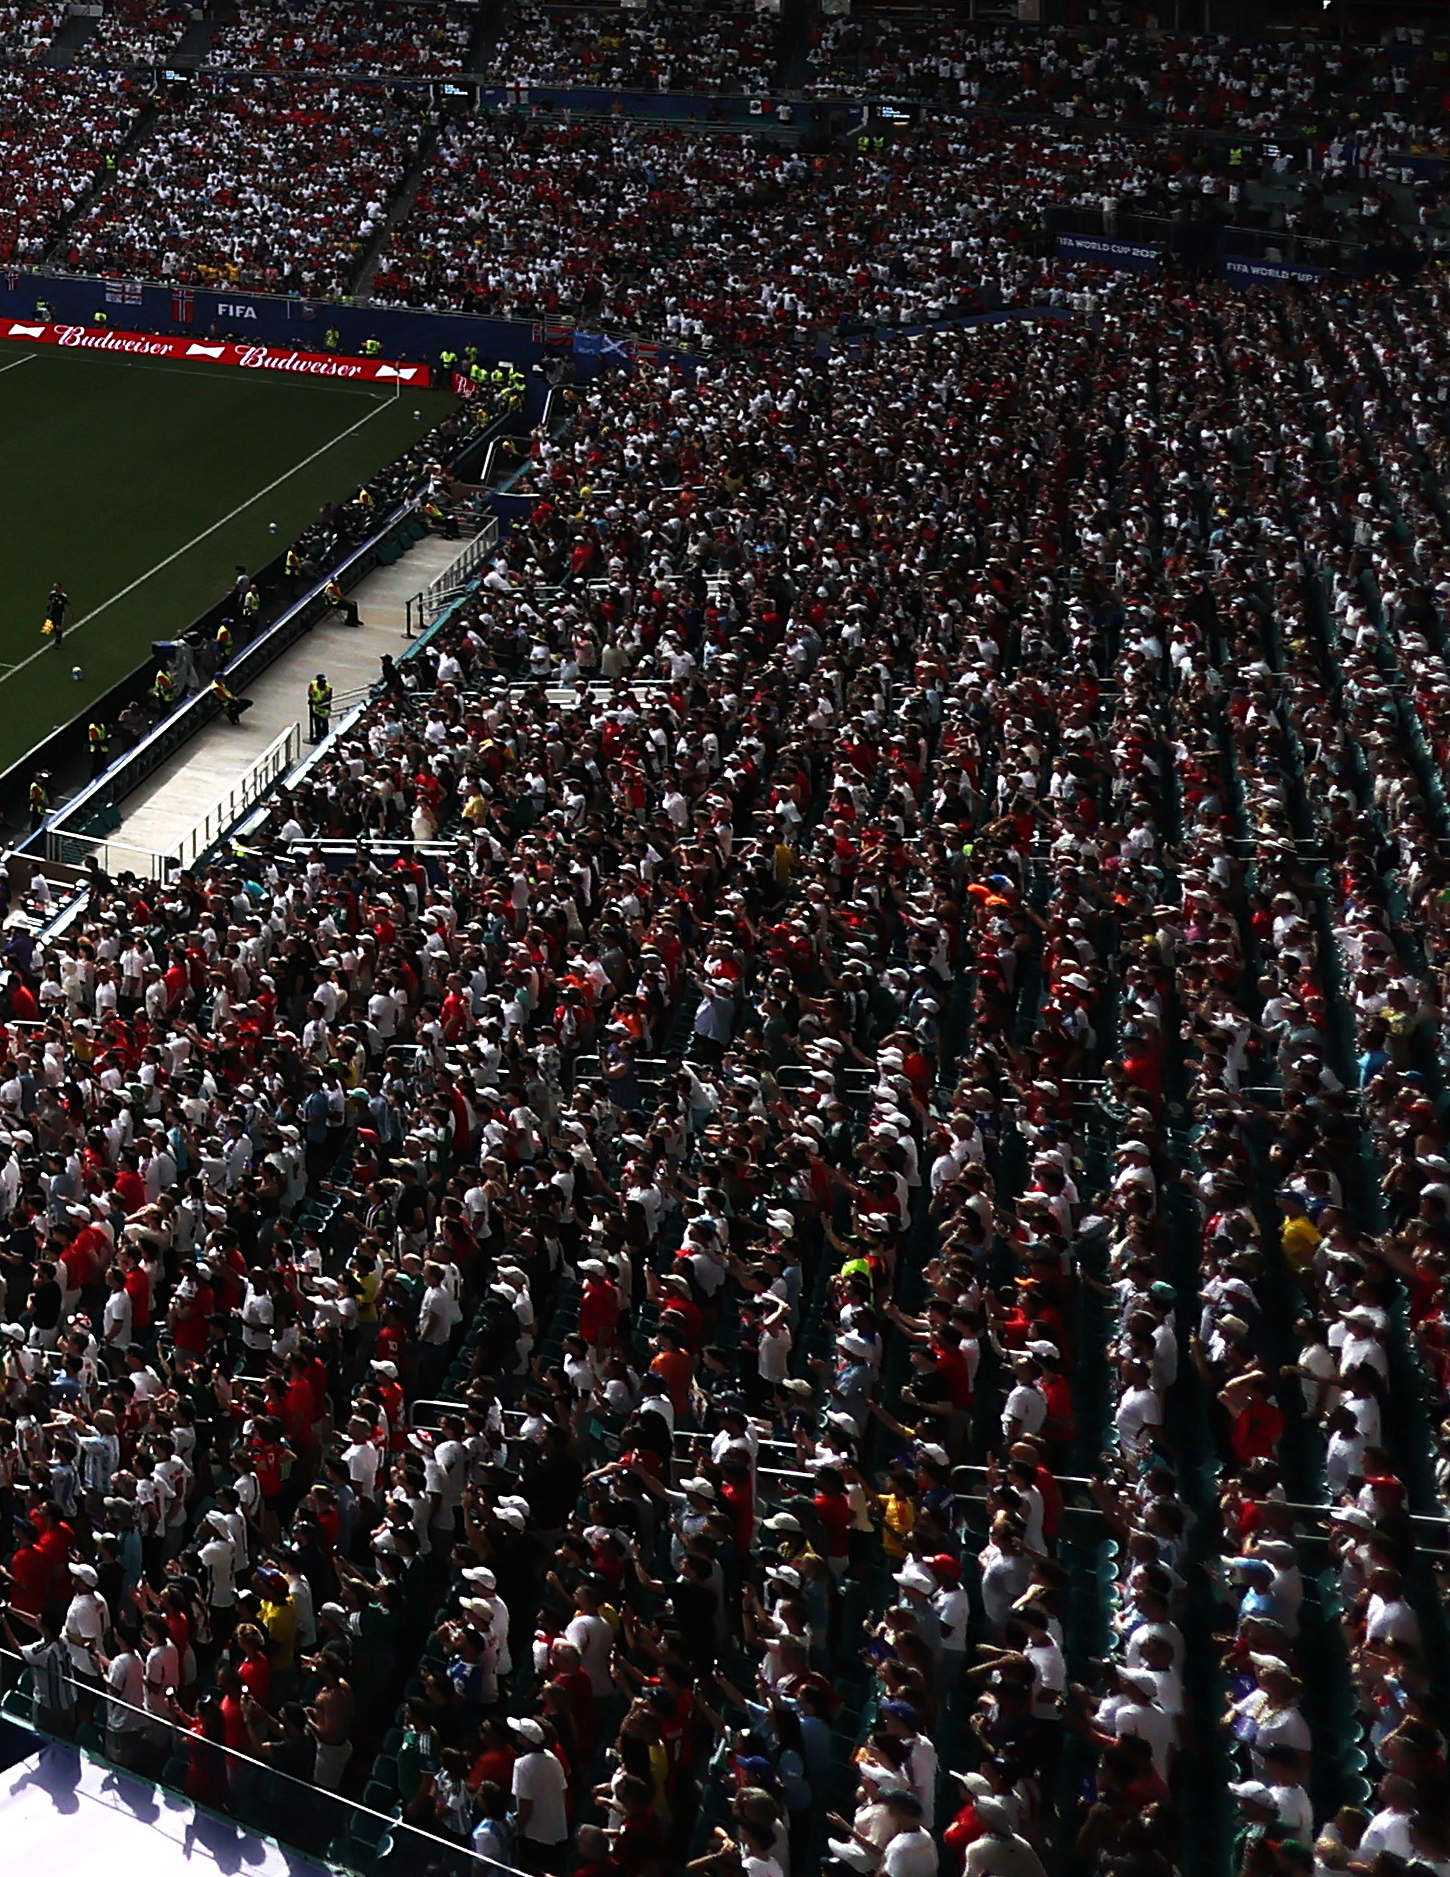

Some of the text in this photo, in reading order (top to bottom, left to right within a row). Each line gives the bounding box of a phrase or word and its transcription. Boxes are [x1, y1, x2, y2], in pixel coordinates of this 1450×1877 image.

[1076, 240, 1110, 251] WORLD
[1111, 245, 1130, 254] CUP
[1227, 263, 1249, 273] FIFA
[1251, 266, 1289, 278] WORLD
[219, 304, 256, 318] FIFA
[54, 325, 172, 354] Budweiser
[235, 345, 363, 376] Budweiser
